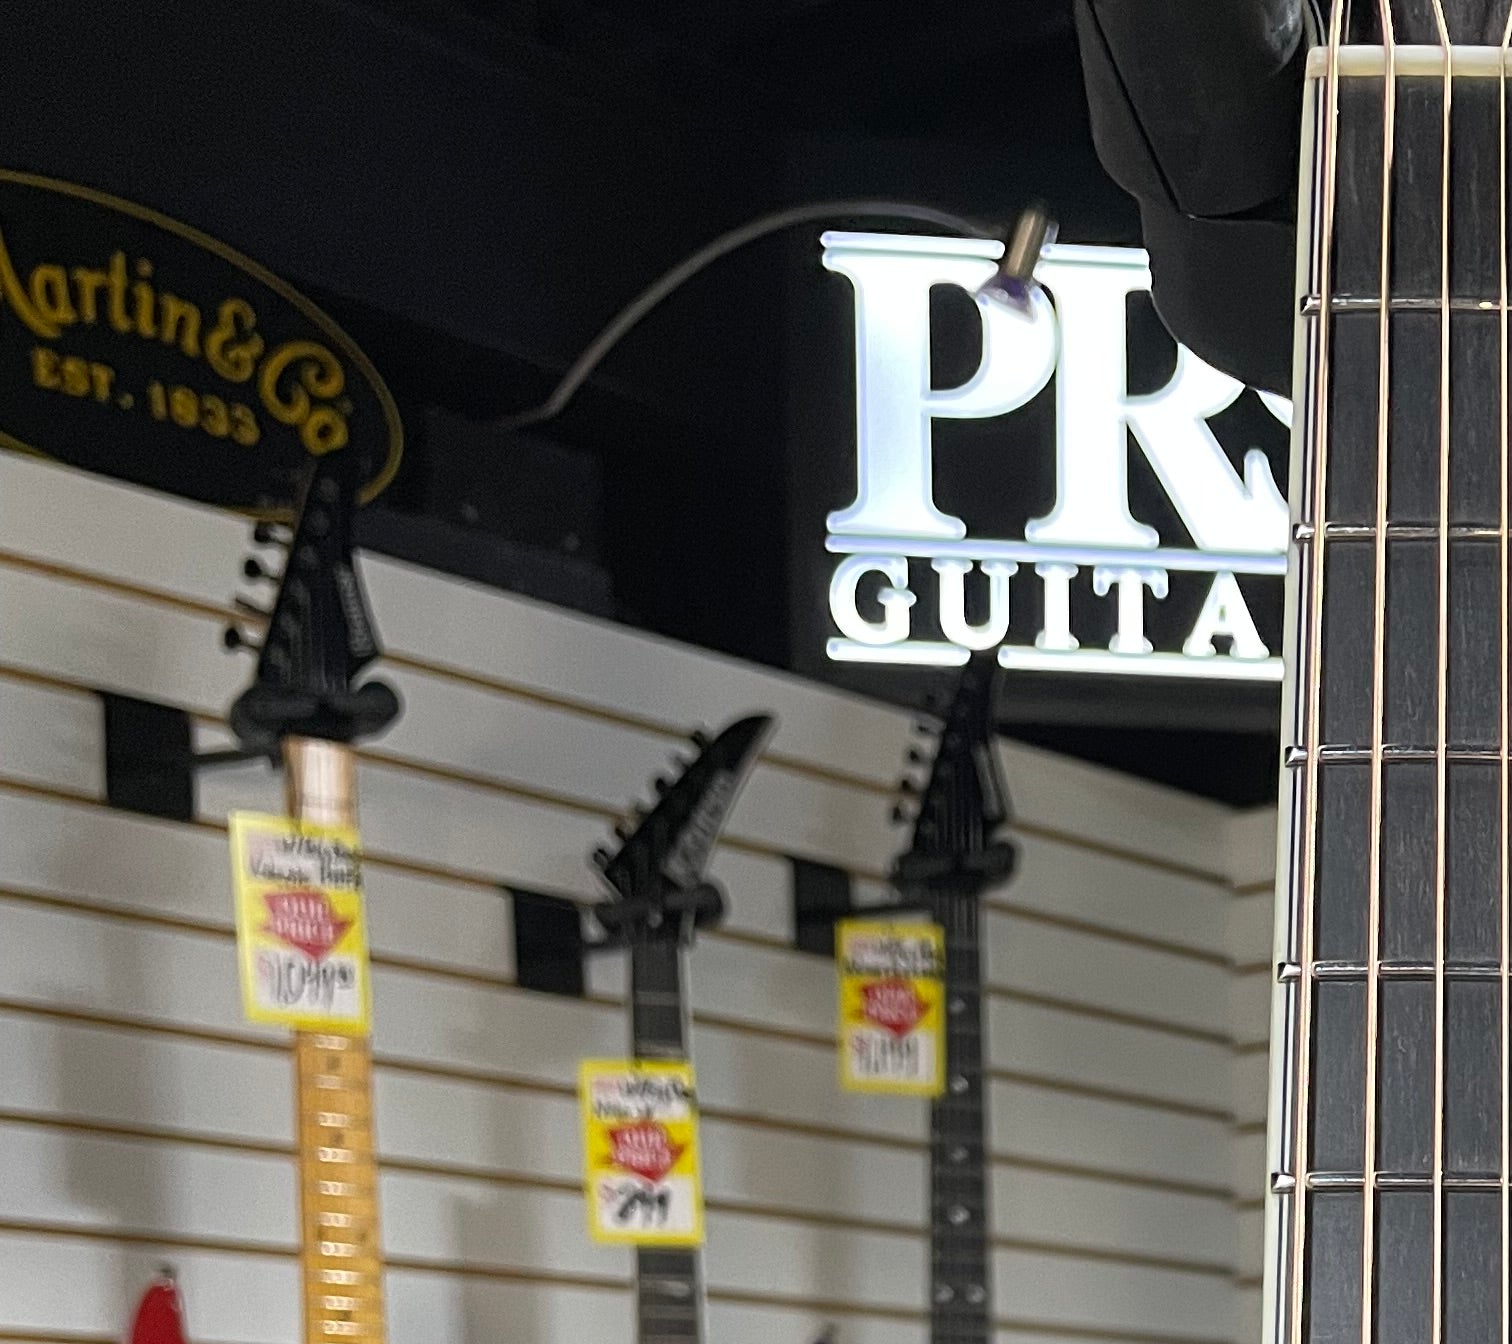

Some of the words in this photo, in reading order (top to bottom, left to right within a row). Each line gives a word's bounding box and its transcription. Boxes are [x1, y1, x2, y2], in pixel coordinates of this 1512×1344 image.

[0, 228, 201, 357] artin
[821, 240, 1291, 553] PR
[828, 553, 1271, 658] GUITA
